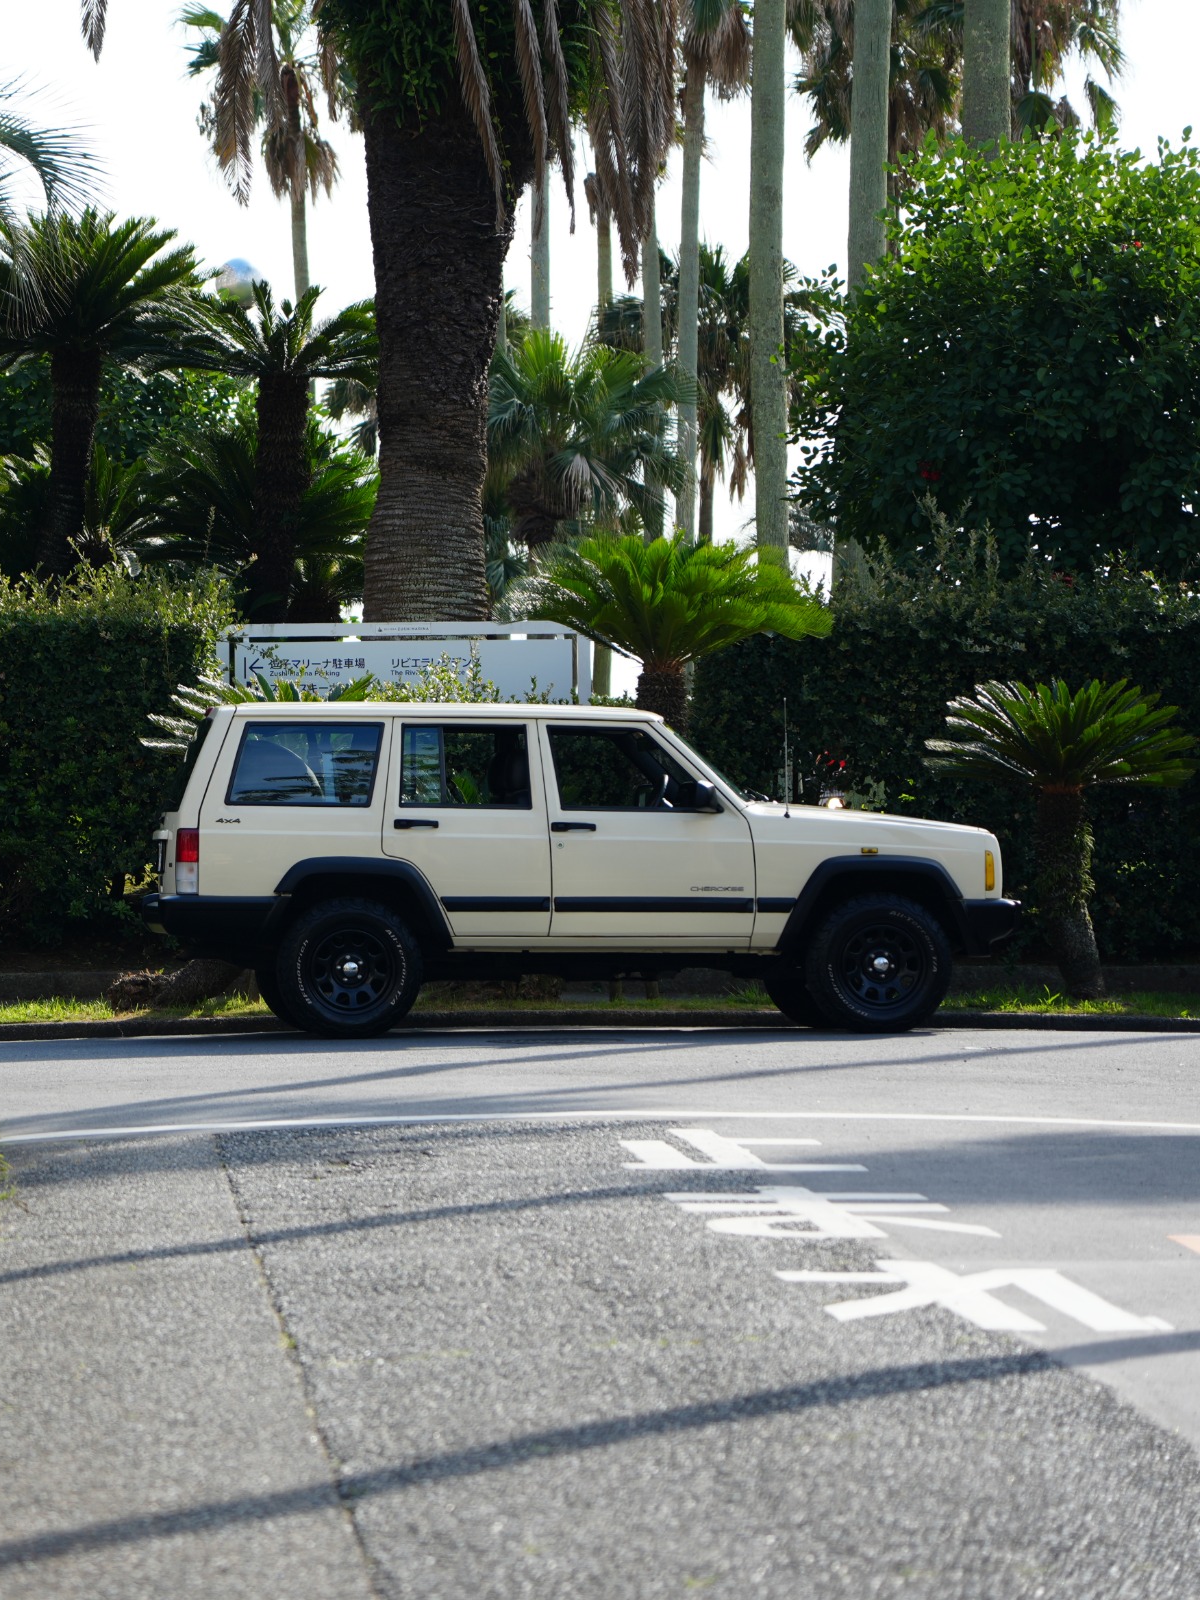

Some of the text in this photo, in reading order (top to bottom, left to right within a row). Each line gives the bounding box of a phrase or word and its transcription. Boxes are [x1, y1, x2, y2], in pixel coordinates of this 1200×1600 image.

[314, 670, 340, 678] Pking
[619, 1128, 1176, 1332] 止まれ
